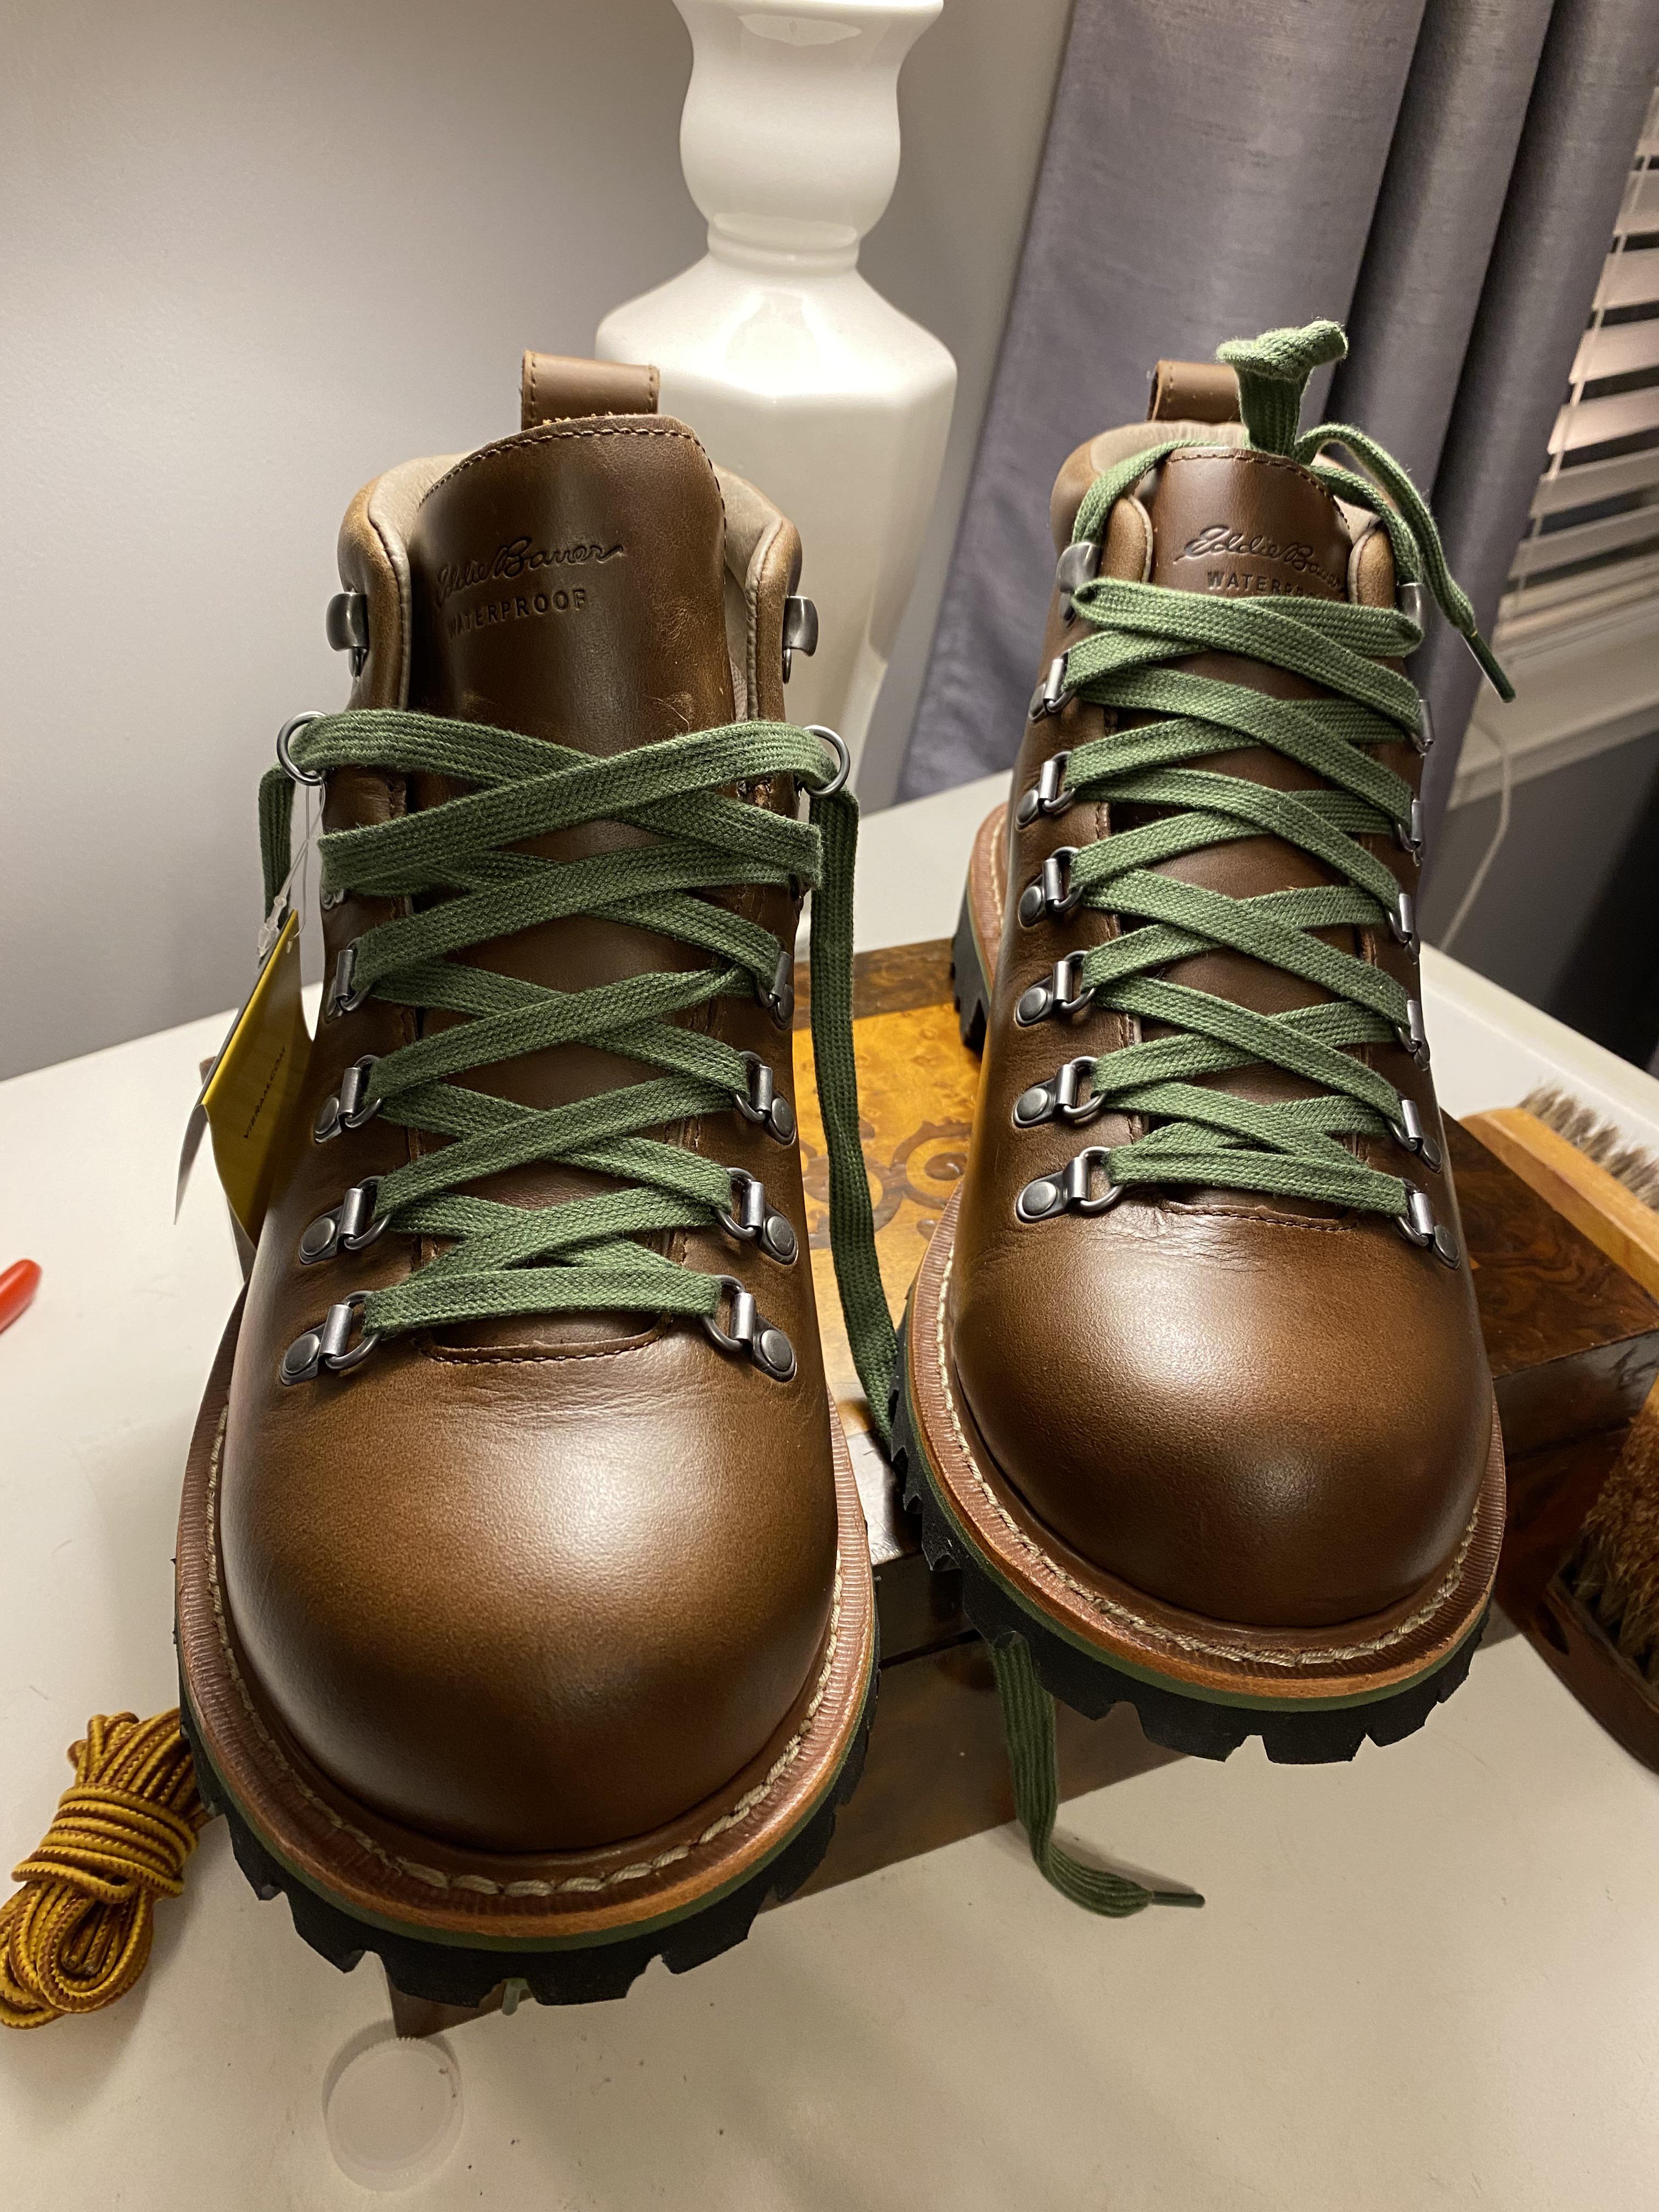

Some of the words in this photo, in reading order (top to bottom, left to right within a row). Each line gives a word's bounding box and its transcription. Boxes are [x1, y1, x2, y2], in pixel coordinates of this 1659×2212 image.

[438, 558, 493, 608] Eddie
[493, 535, 624, 579] Bauer
[1173, 524, 1283, 566] Eddie
[1283, 542, 1344, 590] Bauer
[447, 588, 587, 640] WATERPROOF
